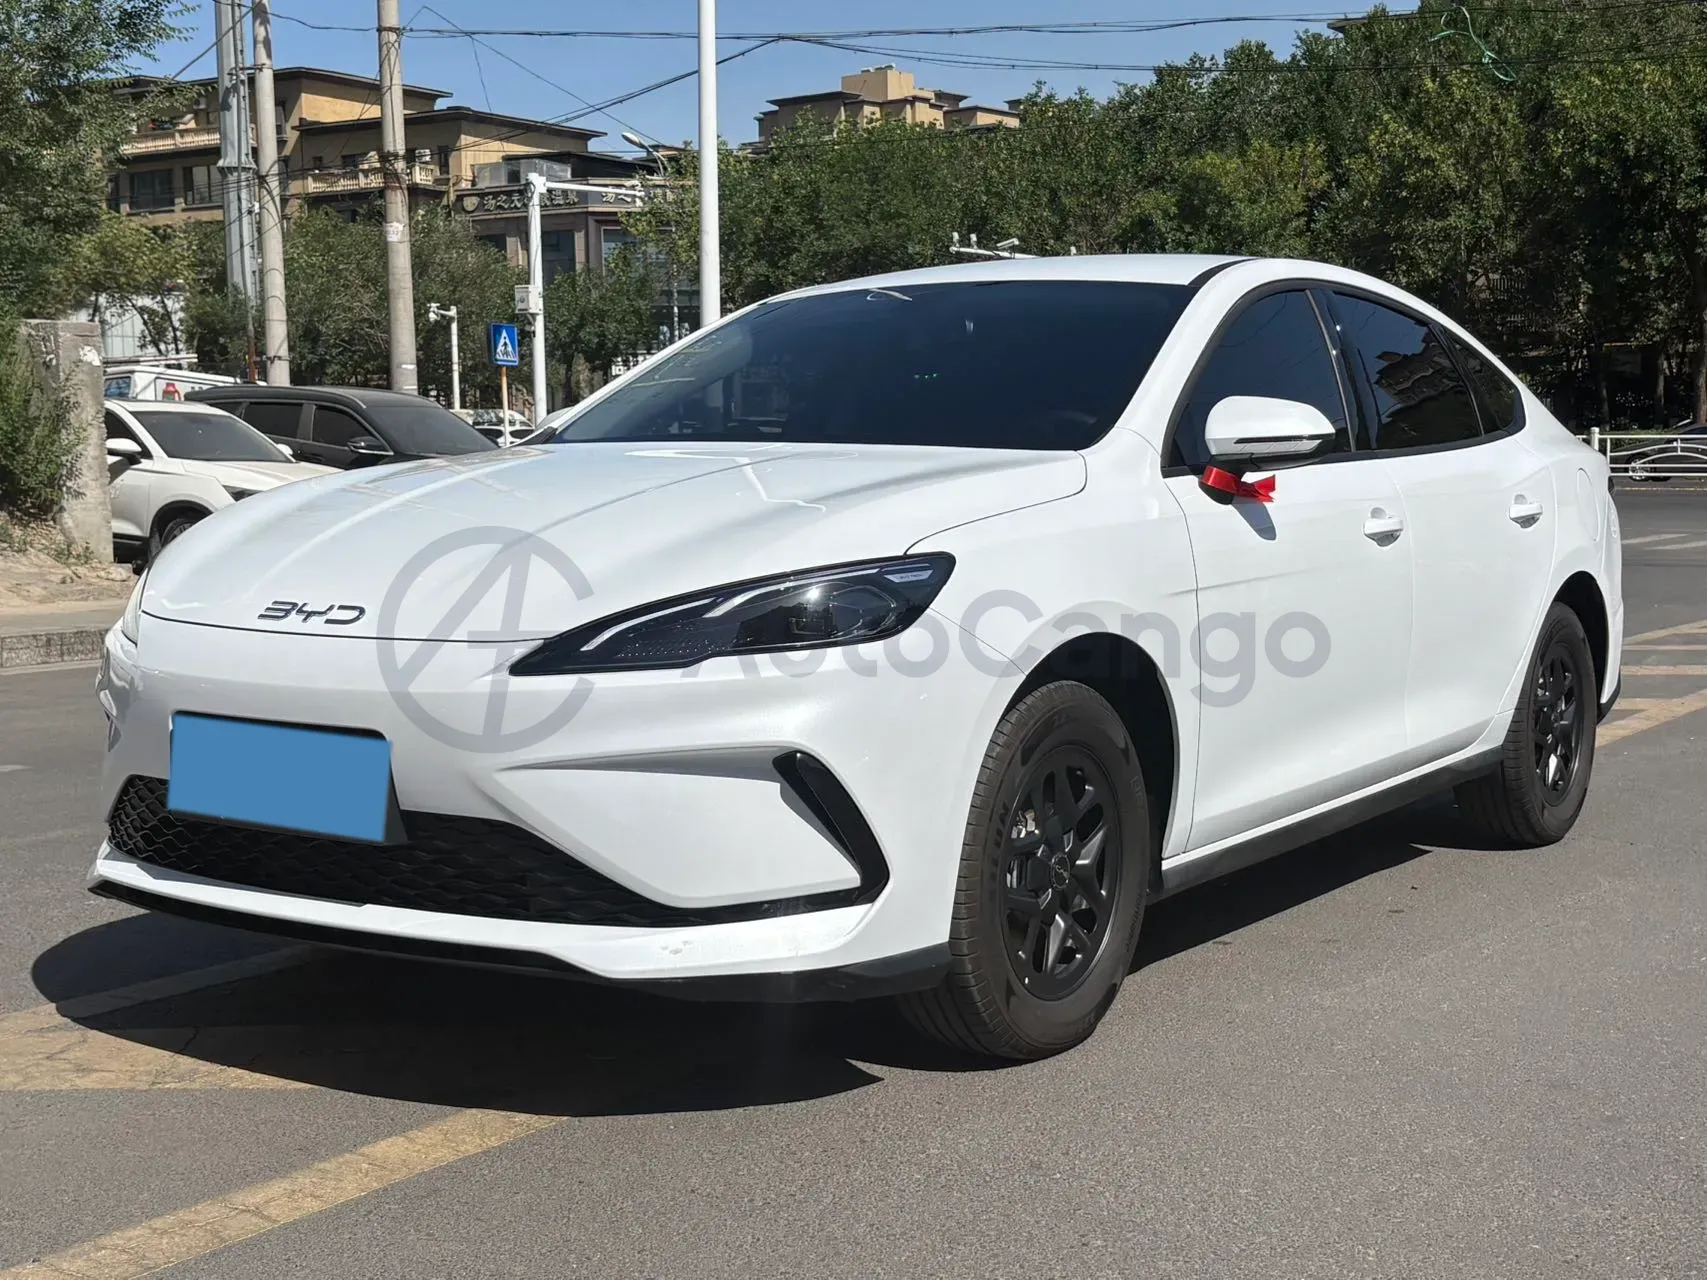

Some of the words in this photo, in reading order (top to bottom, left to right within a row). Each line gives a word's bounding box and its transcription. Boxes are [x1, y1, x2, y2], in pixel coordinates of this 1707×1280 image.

[484, 189, 579, 210] 汤之元温泉
[257, 600, 366, 625] BYD
